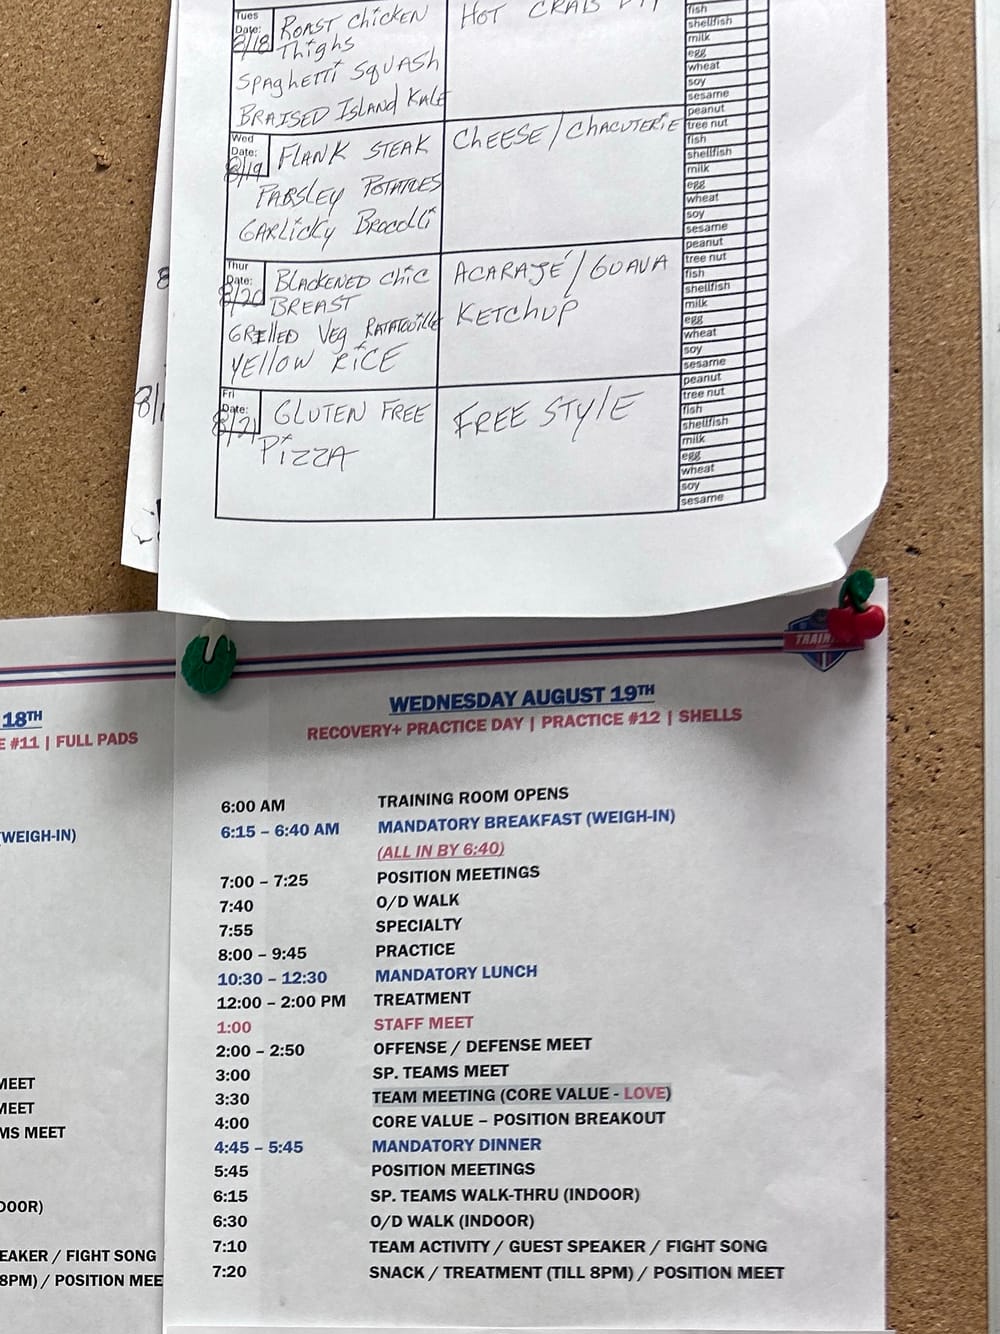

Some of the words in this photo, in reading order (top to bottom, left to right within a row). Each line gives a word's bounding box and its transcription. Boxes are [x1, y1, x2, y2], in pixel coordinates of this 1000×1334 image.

[688, 16, 733, 28] shellfish
[688, 33, 711, 43] milk
[688, 61, 720, 71] wheat
[688, 90, 729, 100] sesame
[687, 105, 725, 116] peanut
[687, 120, 708, 129] tree
[711, 118, 728, 127] nut
[363, 133, 432, 160] STEAK
[381, 398, 431, 424] FREE
[389, 690, 518, 714] WEDNESDAY
[522, 685, 605, 709] AUGUST
[216, 1020, 252, 1034] 1:00
[373, 1017, 425, 1032] STAFF
[428, 1015, 475, 1030] MEET
[372, 1066, 399, 1080] SP.
[402, 1064, 460, 1080] TEAMS
[463, 1063, 510, 1078] MEET
[370, 1214, 403, 1231] O/D
[406, 1214, 455, 1228] WALK
[458, 1214, 535, 1231] (INDOOR)
